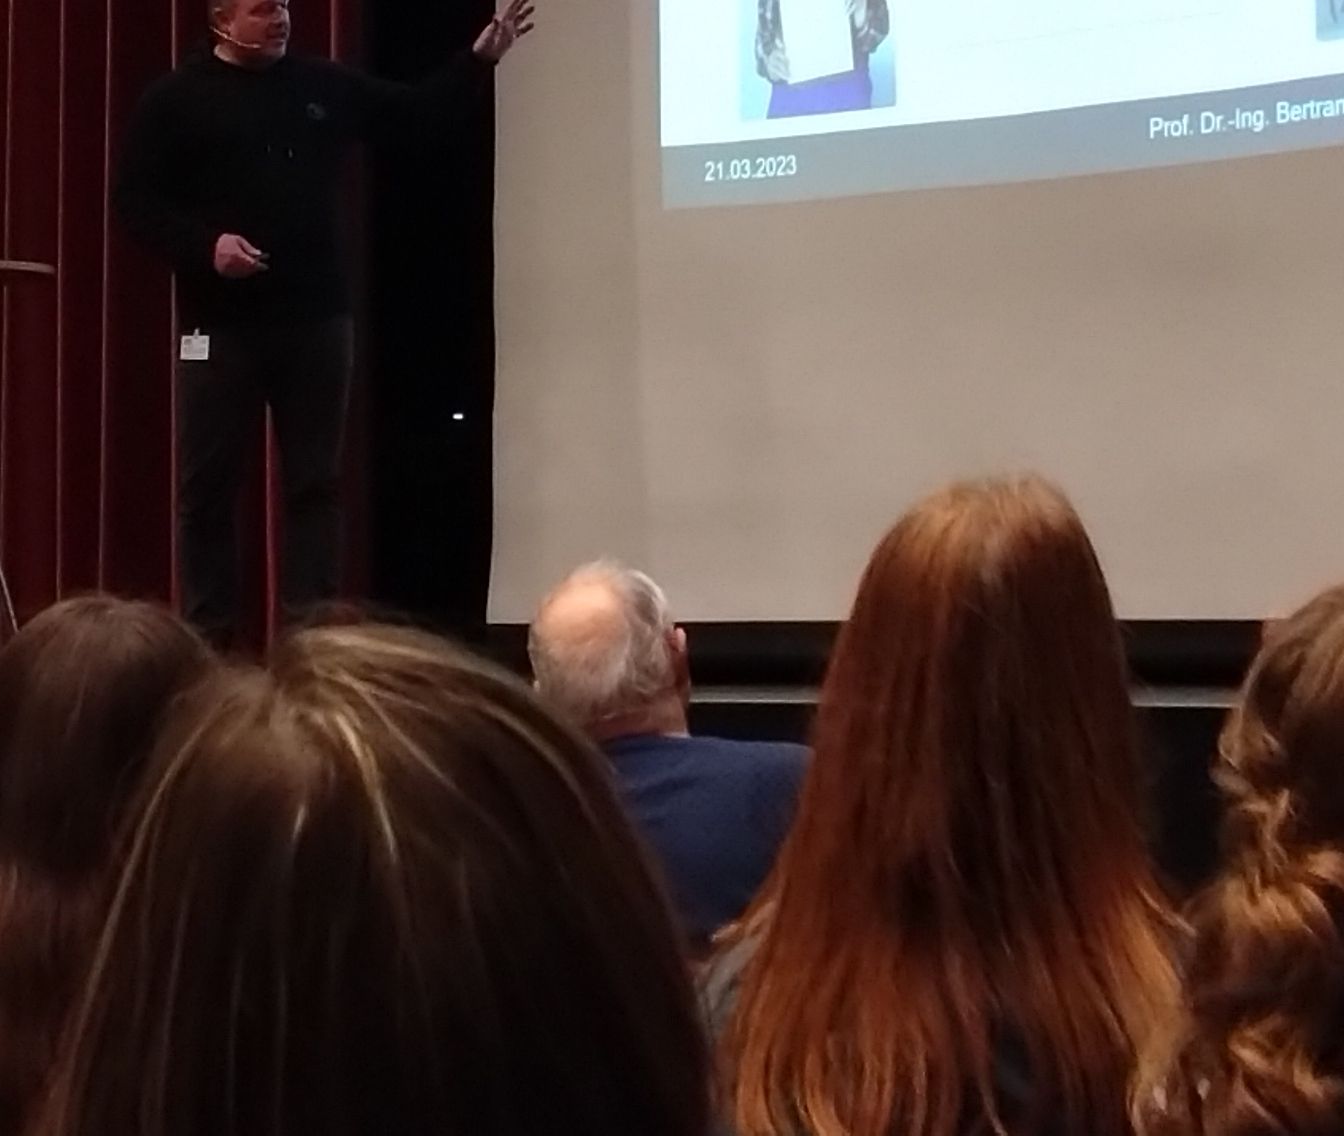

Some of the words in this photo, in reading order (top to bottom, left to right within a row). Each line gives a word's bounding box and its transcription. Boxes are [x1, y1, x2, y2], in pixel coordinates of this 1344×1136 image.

[1148, 114, 1195, 140] Prof.
[1200, 107, 1270, 134] Dr.-Ing.
[703, 155, 798, 183] 21.03.2023
